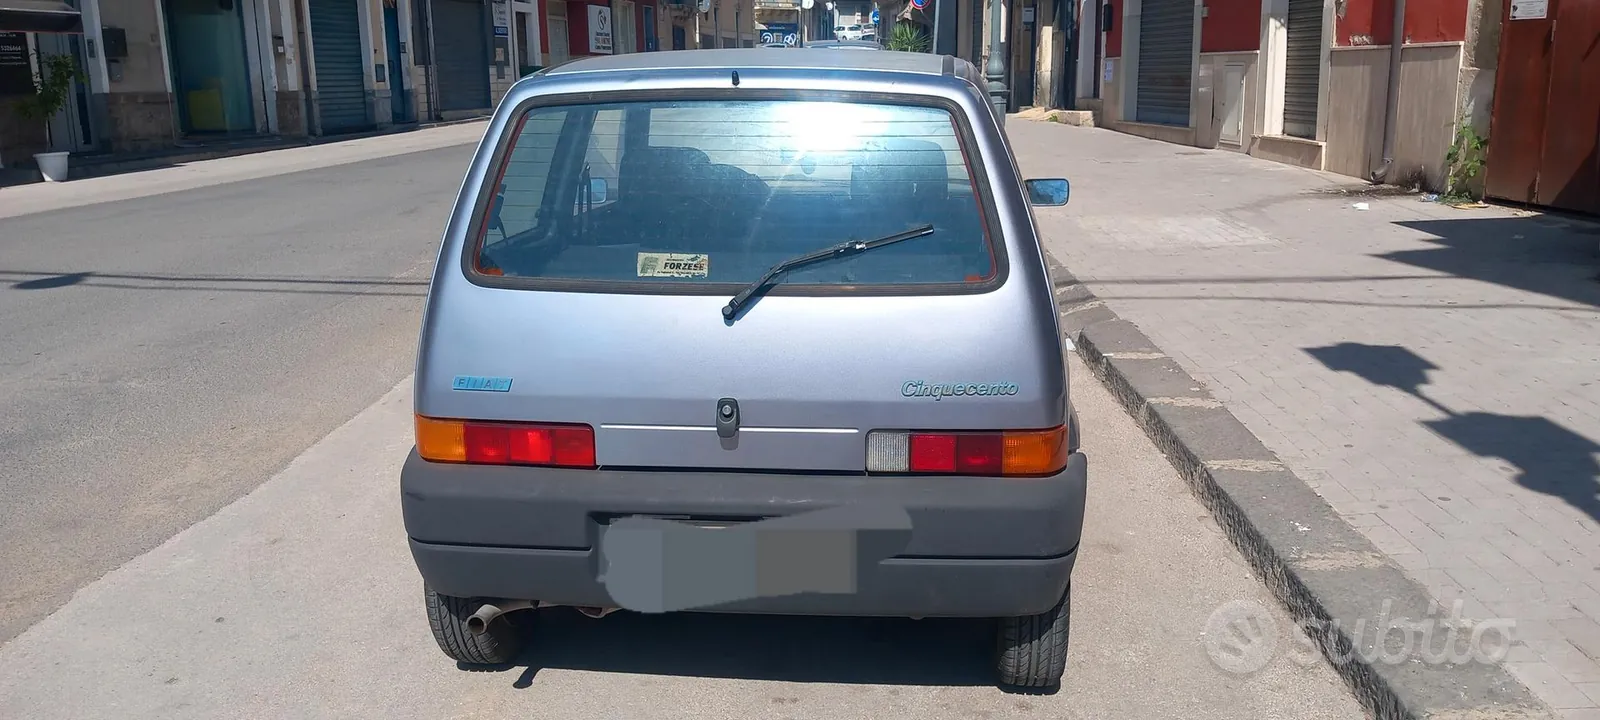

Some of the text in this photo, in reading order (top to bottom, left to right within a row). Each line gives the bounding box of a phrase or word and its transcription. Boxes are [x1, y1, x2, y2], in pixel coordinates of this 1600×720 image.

[663, 262, 706, 271] FORZESE
[458, 378, 508, 389] FIAT
[901, 380, 1020, 401] Cinquecento
